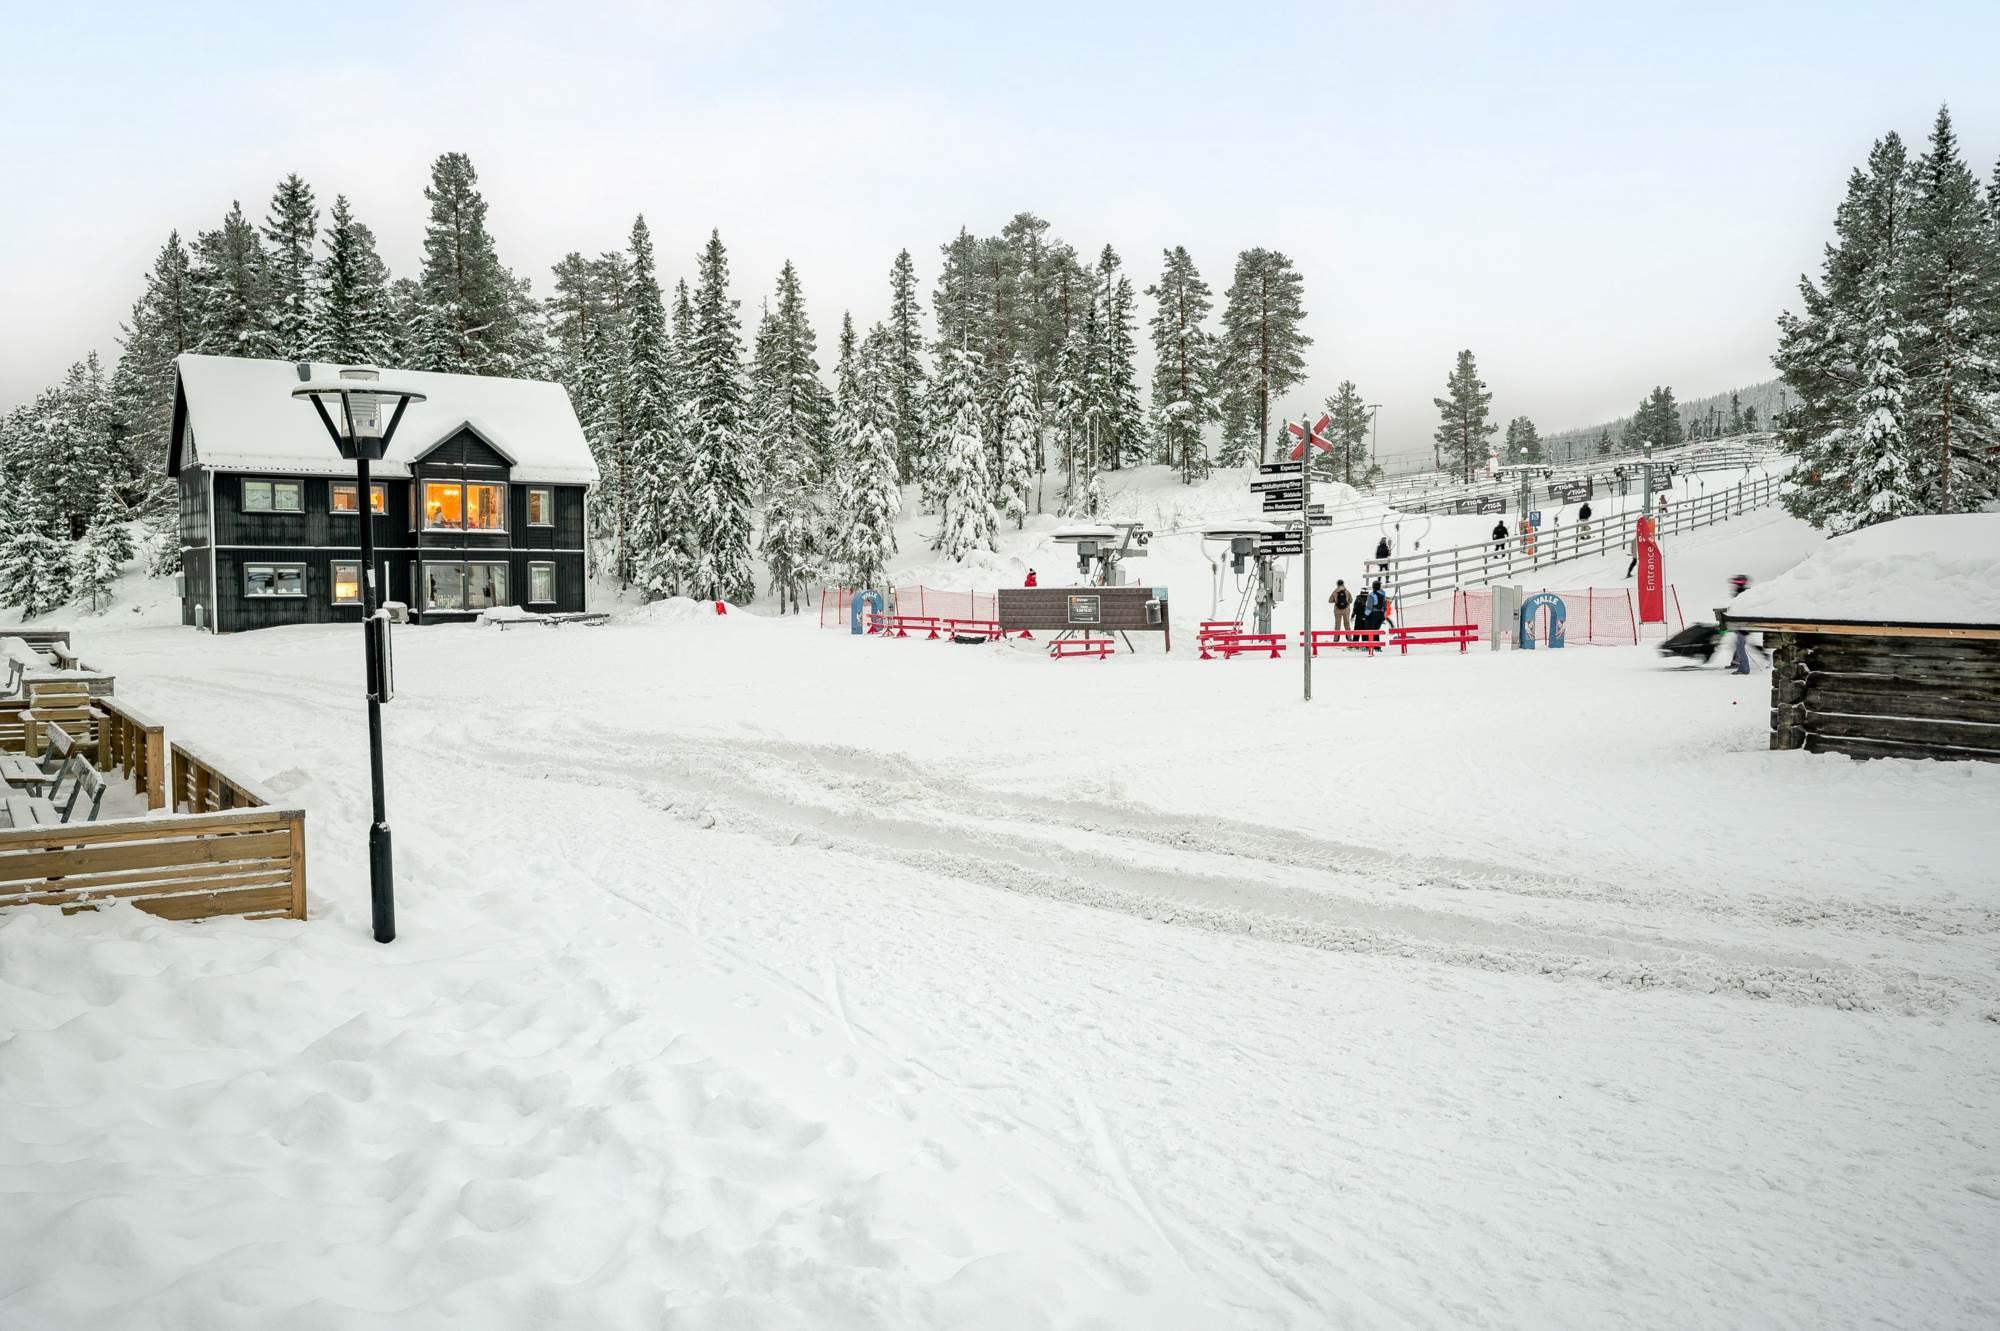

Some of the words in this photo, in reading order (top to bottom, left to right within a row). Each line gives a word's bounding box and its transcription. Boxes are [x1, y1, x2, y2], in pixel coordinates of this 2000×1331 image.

[1553, 483, 1574, 491] STIGA
[1567, 488, 1587, 496] STIGA
[1482, 502, 1502, 510] STIGA
[1646, 547, 1655, 591] Entrance
[861, 591, 878, 600] VALLE
[1533, 595, 1559, 606] VALLE
